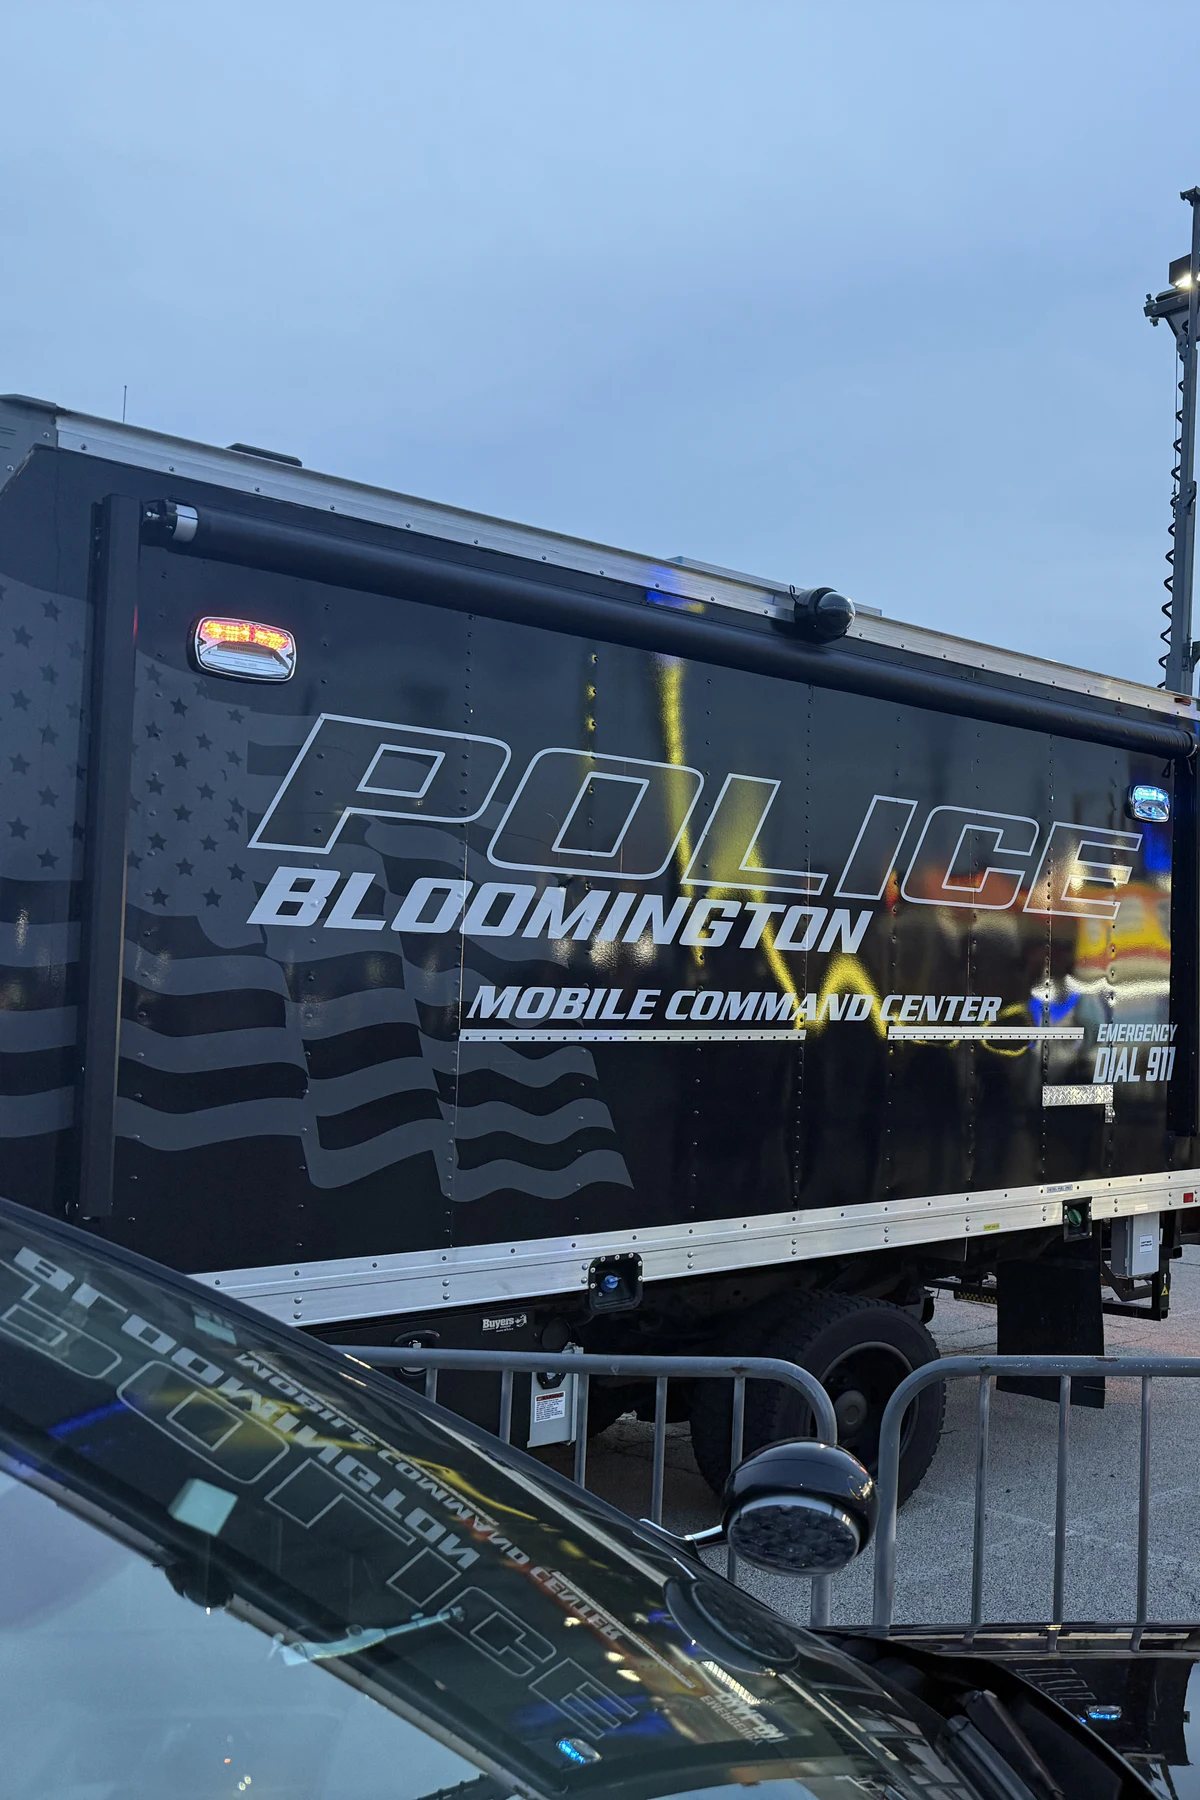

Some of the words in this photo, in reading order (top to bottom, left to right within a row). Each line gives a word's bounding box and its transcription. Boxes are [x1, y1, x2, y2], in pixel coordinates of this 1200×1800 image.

[247, 713, 1143, 919] POLICE
[246, 866, 873, 953] BLOOMINGTON
[466, 985, 661, 1020] MOBILE
[665, 988, 873, 1022] COMMAND
[880, 994, 1003, 1022] CENTER
[1097, 1024, 1178, 1042] EMERGENCY
[1093, 1046, 1140, 1083] DIAL
[1146, 1046, 1176, 1081] 911
[482, 1317, 515, 1330] Buyers
